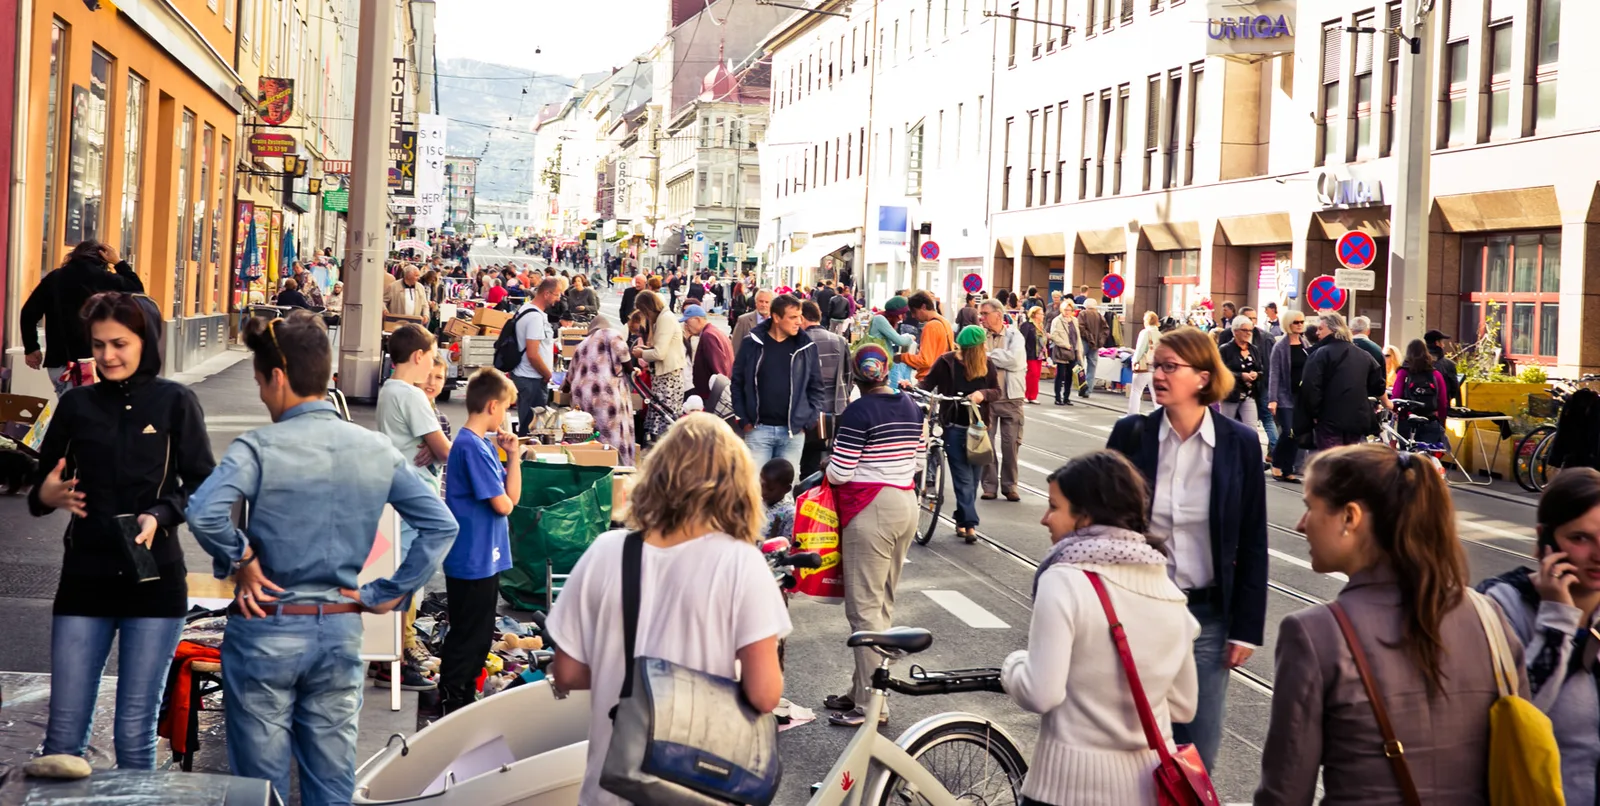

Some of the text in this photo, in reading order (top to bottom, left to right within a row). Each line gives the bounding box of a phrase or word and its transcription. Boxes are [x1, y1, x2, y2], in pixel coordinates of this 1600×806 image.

[1207, 14, 1292, 40] UNIQA
[390, 61, 405, 145] HOTEL
[617, 161, 627, 203] GROHS
